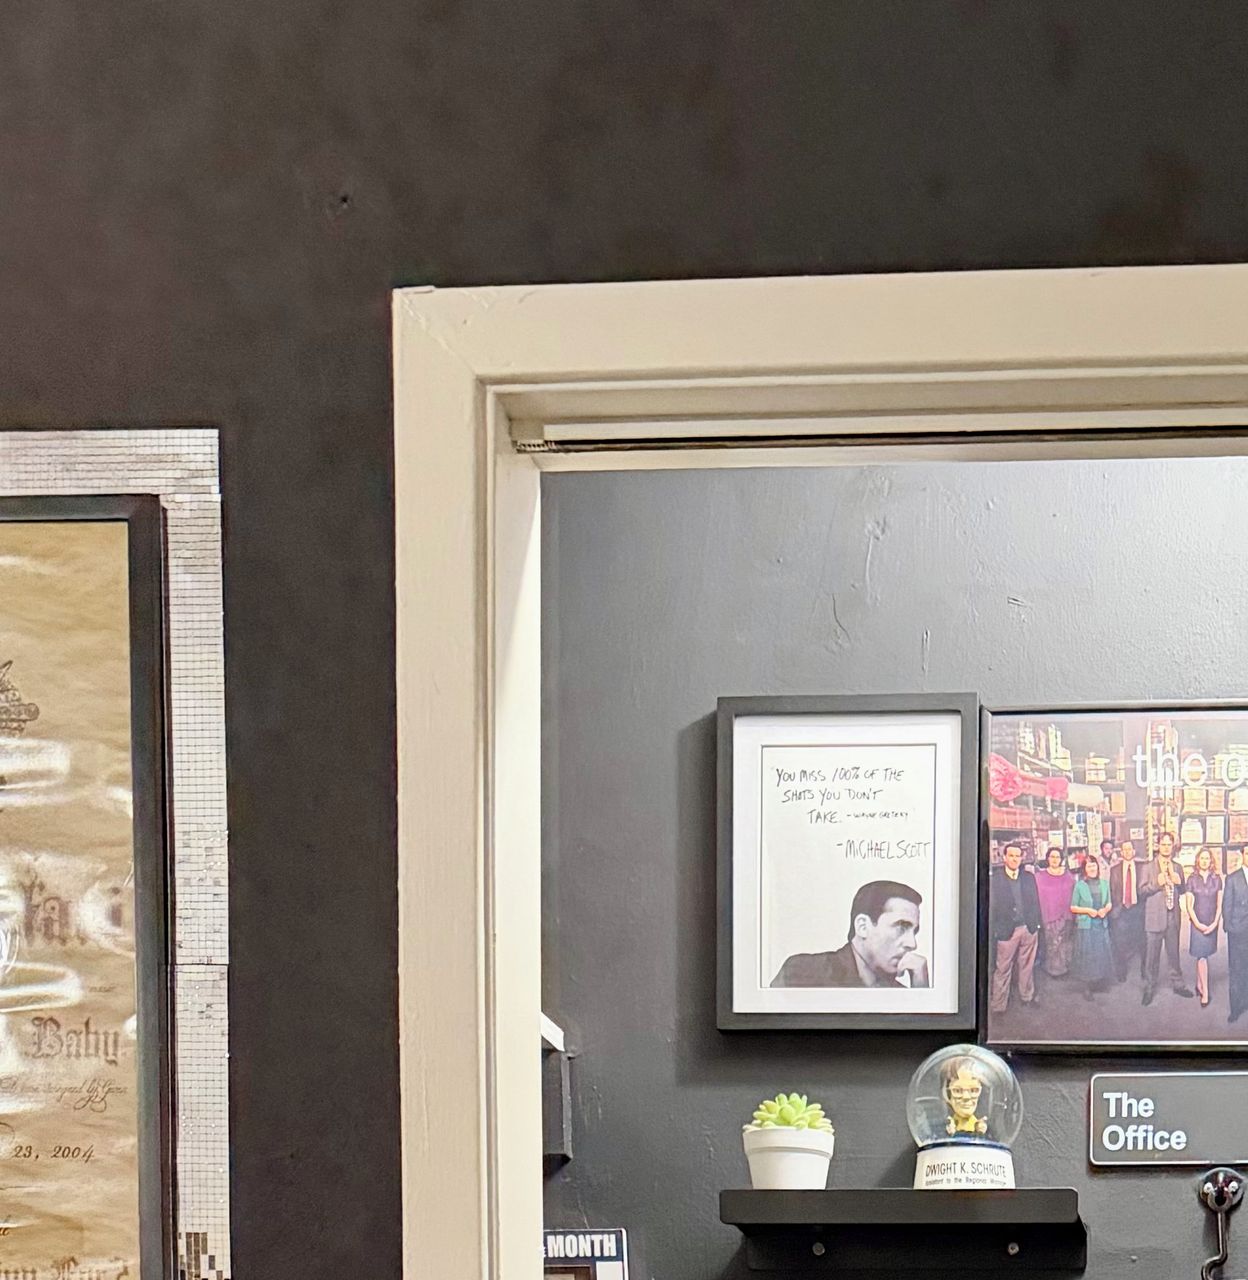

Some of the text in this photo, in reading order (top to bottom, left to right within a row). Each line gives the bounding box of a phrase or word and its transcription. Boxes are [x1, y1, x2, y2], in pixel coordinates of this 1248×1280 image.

[1132, 743, 1208, 788] the
[776, 766, 905, 787] YOU MISS 100% OF THE
[781, 788, 884, 806] SHOTS YOU DON'T
[896, 839, 932, 858] SCOTT
[1103, 1092, 1154, 1118] The
[1102, 1124, 1187, 1151] Office
[51, 1144, 95, 1163] 2004
[925, 1162, 1007, 1178] DWIGHT K. SCHRUTE
[547, 1234, 617, 1258] MONTH
